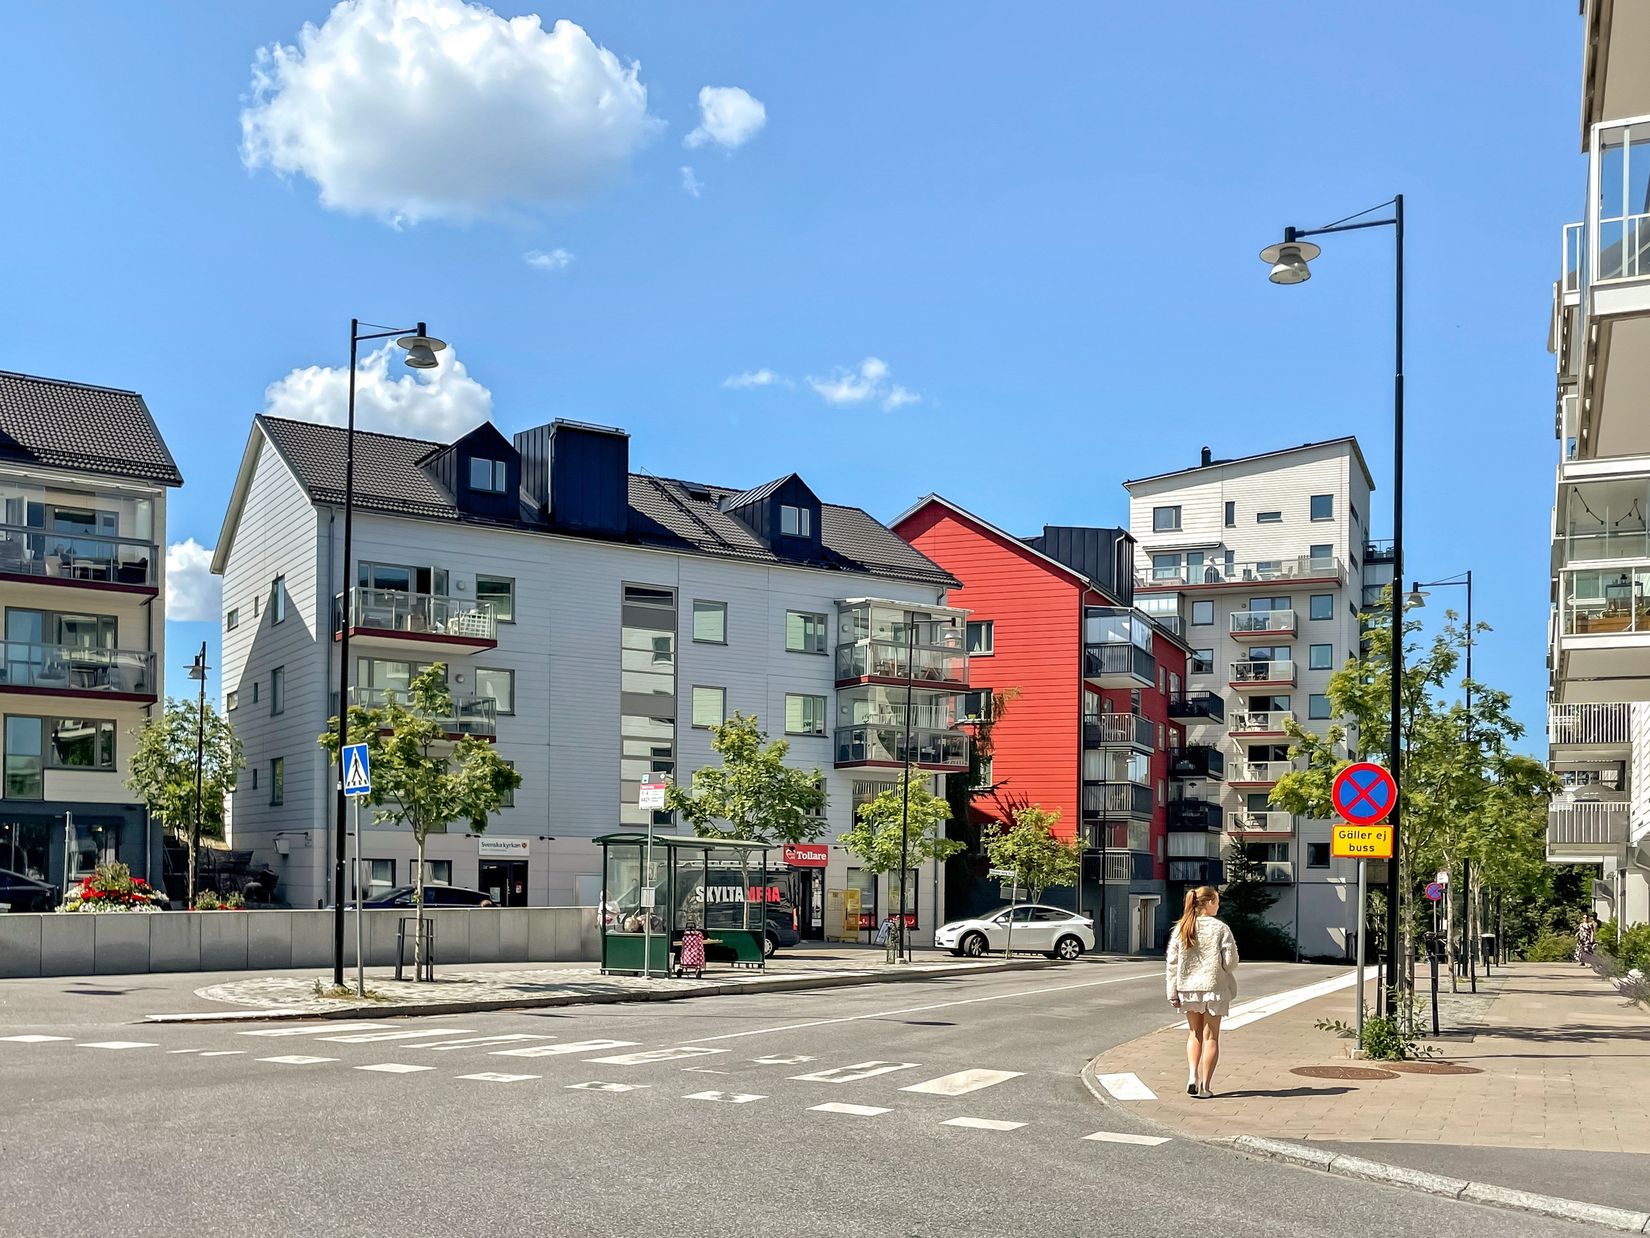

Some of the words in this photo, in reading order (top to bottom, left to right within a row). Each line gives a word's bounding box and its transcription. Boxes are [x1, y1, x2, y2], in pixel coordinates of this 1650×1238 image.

[1338, 830, 1372, 840] Gäller
[1376, 830, 1387, 841] ej
[503, 841, 521, 850] kyrkan
[1349, 843, 1375, 852] buss
[796, 851, 827, 860] Tollare
